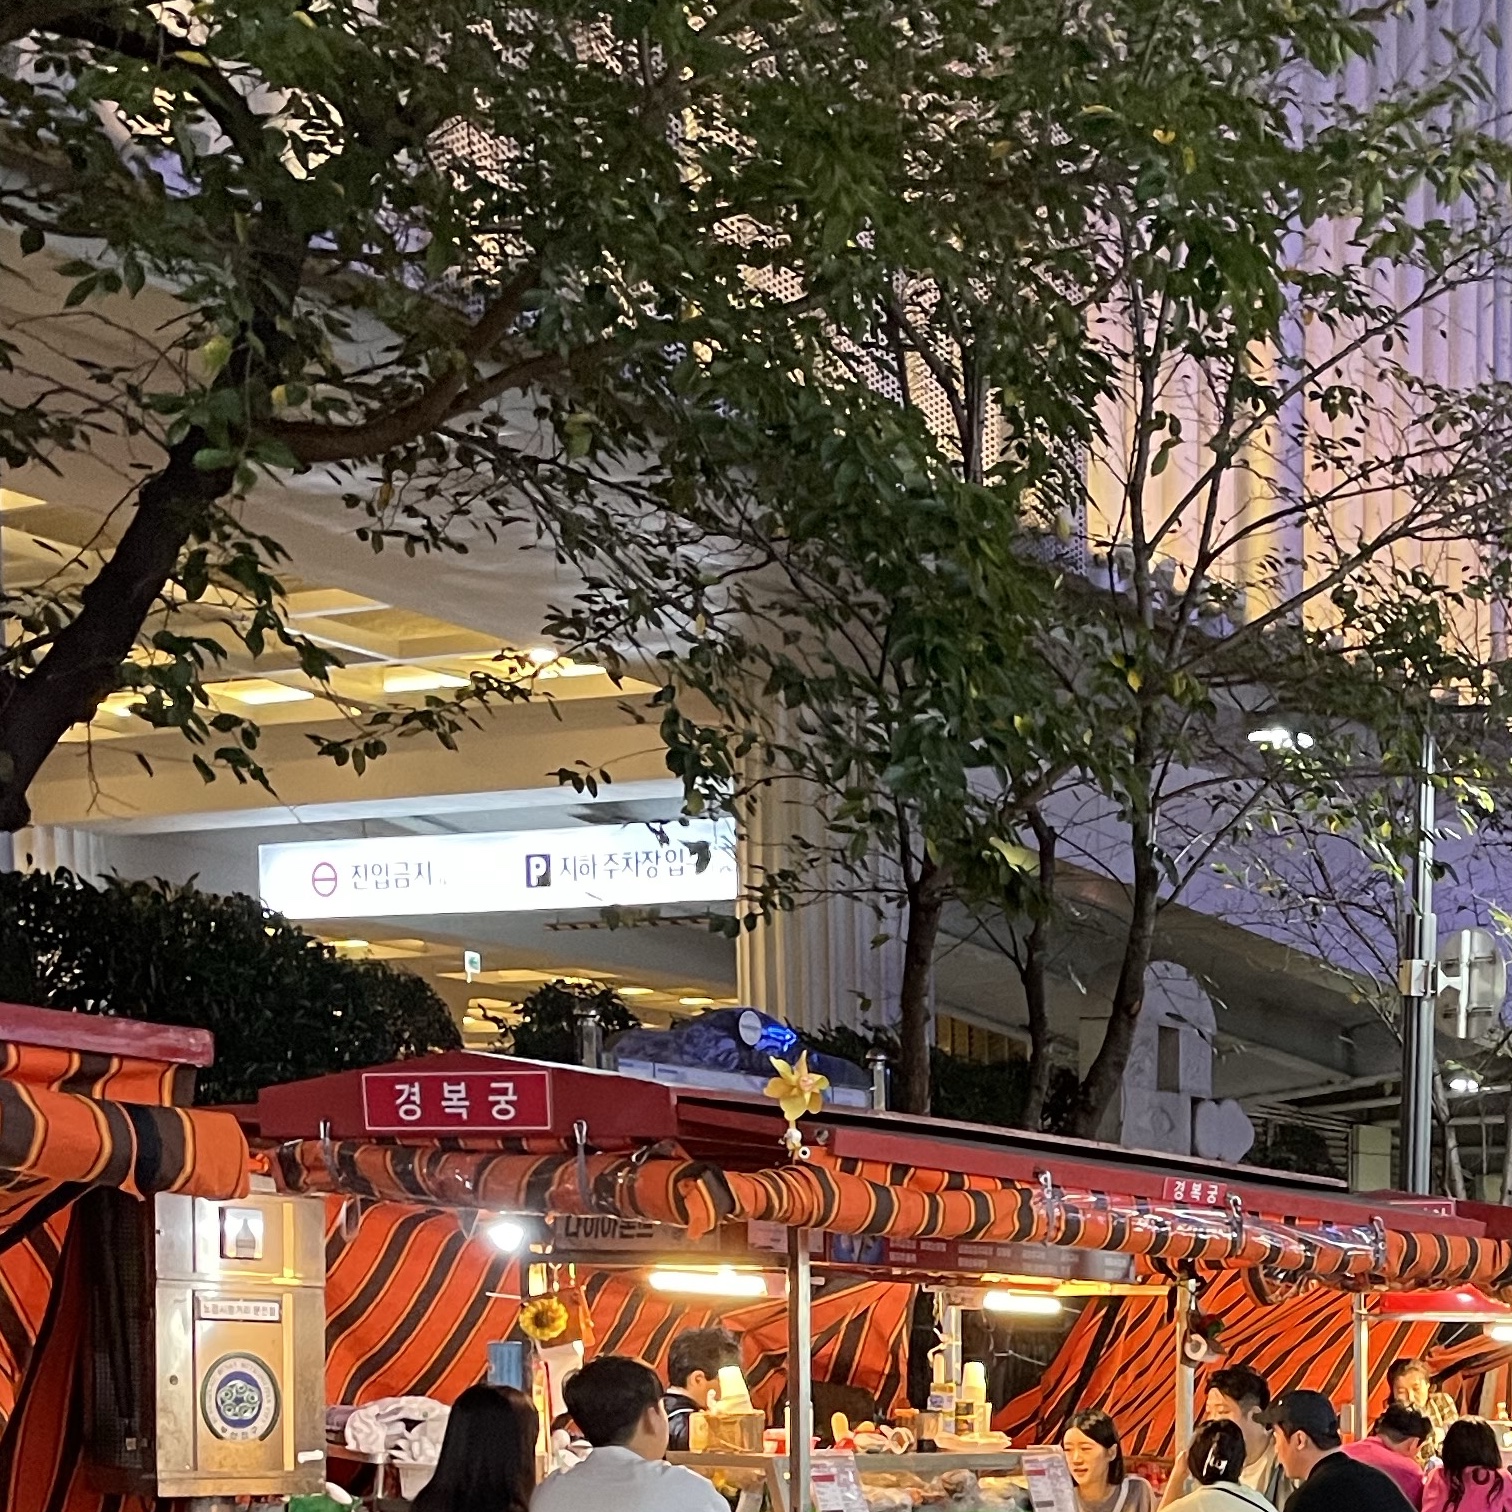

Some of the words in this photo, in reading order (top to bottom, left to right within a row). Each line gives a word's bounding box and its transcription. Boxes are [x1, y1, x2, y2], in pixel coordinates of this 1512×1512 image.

[350, 860, 434, 890] 진입금지
[560, 854, 598, 882] 지하
[602, 851, 661, 881] 주차장
[394, 1081, 519, 1121] 경복궁
[1173, 1181, 1219, 1205] 경복궁
